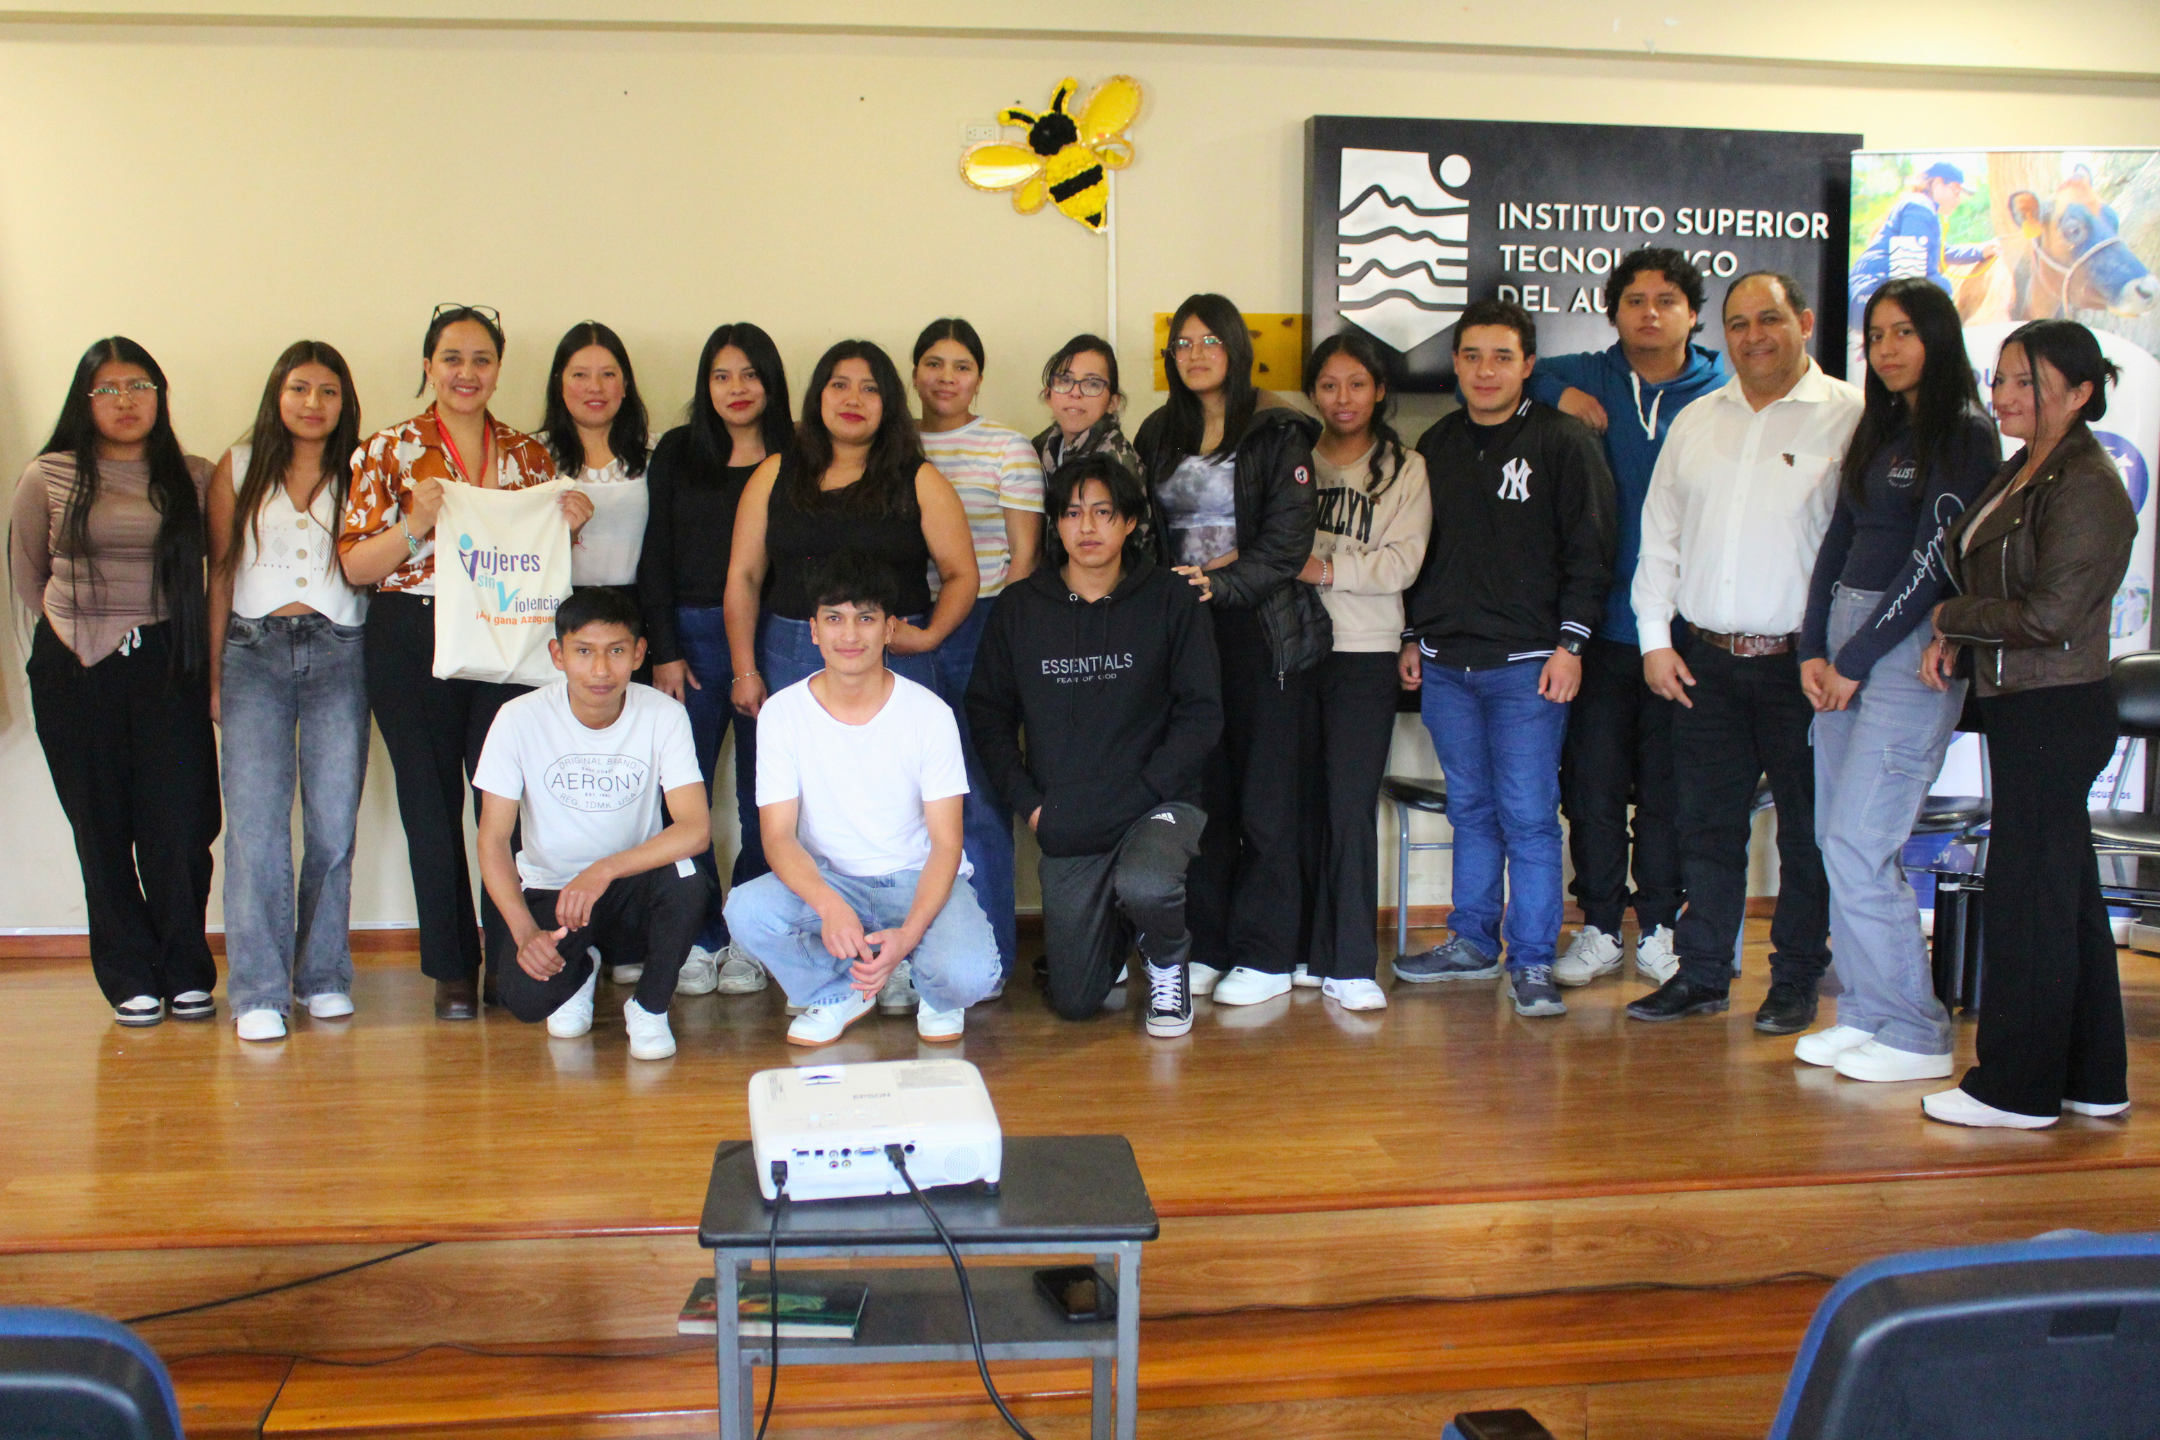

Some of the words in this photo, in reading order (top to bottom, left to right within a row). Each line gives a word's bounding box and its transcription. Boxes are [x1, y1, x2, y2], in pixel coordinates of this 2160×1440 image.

[1498, 202, 1666, 233] INSTITUTO
[1676, 207, 1829, 240] SUPERIOR
[1499, 241, 1738, 277] TECNOLCO
[1497, 284, 1560, 313] DEL
[478, 573, 495, 589] sin
[496, 581, 560, 613] Violencia
[494, 616, 517, 626] gana
[1041, 653, 1133, 675] ESSENTIALS
[559, 756, 603, 769] ORIGINAL
[606, 758, 637, 769] BRAND
[551, 770, 644, 792] AERONY
[560, 793, 578, 806] REG
[585, 801, 612, 809] TDMK
[618, 793, 637, 806] USA
